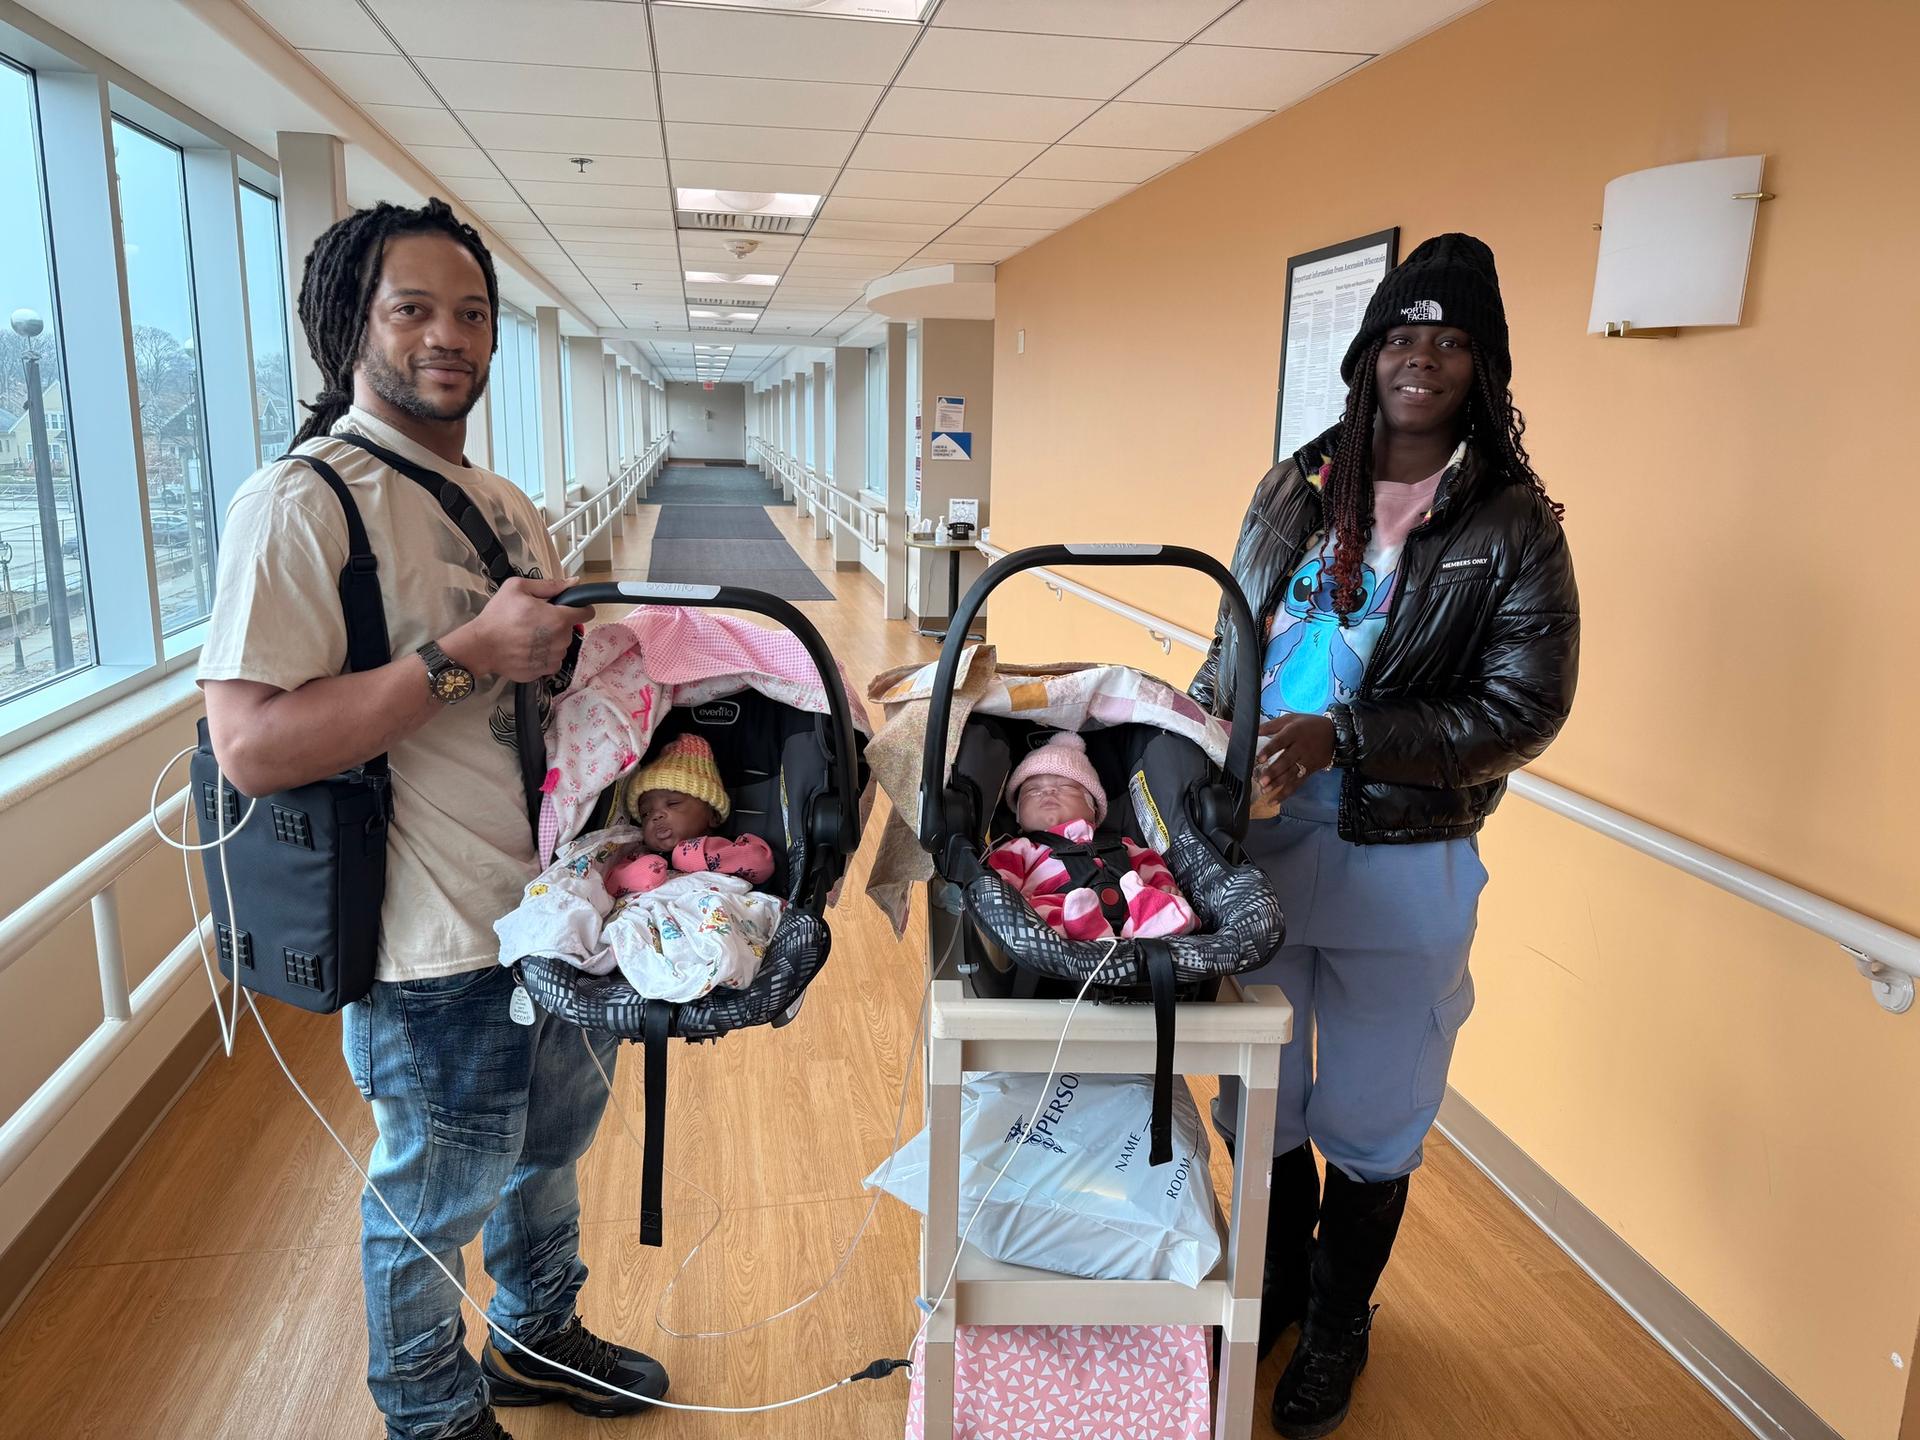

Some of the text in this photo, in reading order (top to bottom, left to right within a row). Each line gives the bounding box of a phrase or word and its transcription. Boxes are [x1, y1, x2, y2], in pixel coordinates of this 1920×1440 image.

[1414, 300, 1430, 308] THE
[1400, 307, 1429, 315] NORTH
[1407, 313, 1429, 321] FACE
[1442, 560, 1471, 569] MEMBERS
[699, 706, 733, 717] evenflo
[1035, 1073, 1081, 1136] PERSO
[1115, 1132, 1141, 1173] NAME
[1166, 1157, 1191, 1200] ROOM
